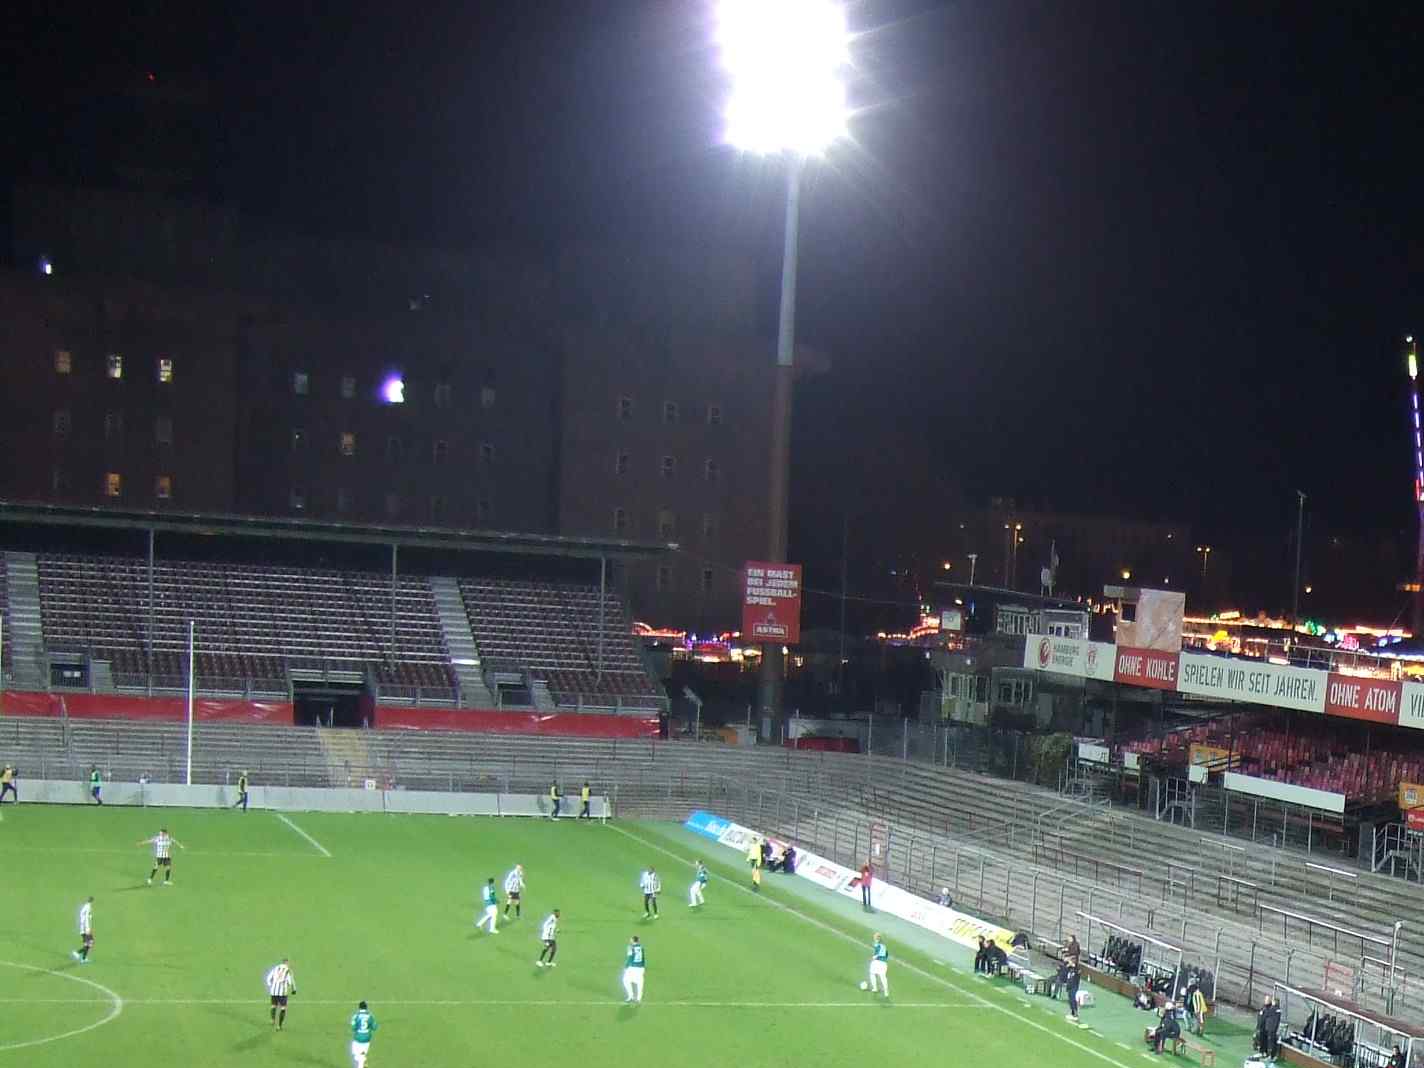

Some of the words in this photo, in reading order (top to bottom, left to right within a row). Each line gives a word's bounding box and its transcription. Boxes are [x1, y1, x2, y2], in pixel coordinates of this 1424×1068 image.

[1118, 655, 1141, 676] OHNE
[1145, 658, 1176, 681] KOHLE
[1184, 664, 1224, 688] SPIELEN
[1227, 670, 1246, 692] WIR
[1248, 672, 1271, 694] SEIT
[1274, 676, 1318, 702] JAHREN.
[1330, 682, 1360, 708] OHNE
[1364, 687, 1396, 713] ATOM
